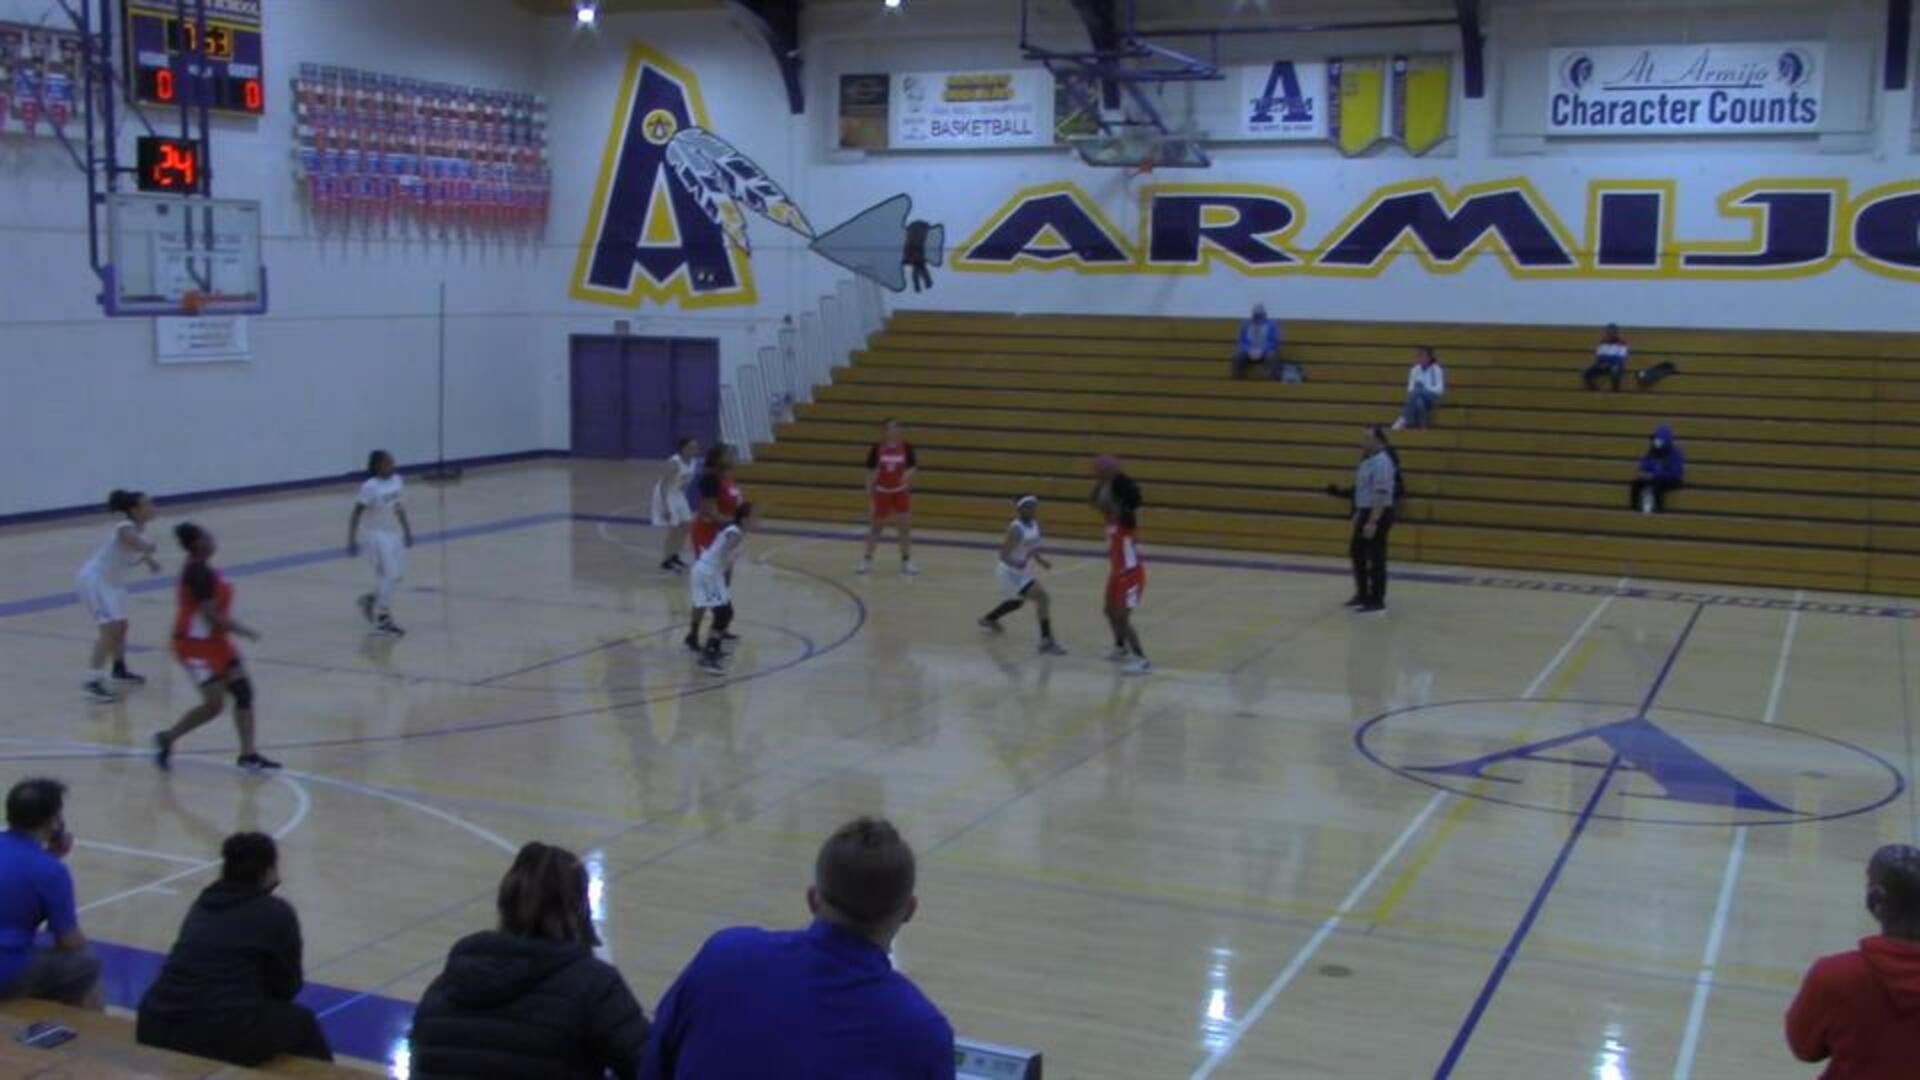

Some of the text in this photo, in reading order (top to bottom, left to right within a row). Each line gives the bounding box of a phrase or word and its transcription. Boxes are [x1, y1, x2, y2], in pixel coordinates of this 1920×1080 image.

[157, 68, 173, 100] 0
[1662, 48, 1770, 87] Armijo
[244, 79, 262, 110] 0
[1552, 90, 1817, 126] Character Counts
[930, 118, 1033, 137] BASKETBALL
[152, 143, 195, 186] 24
